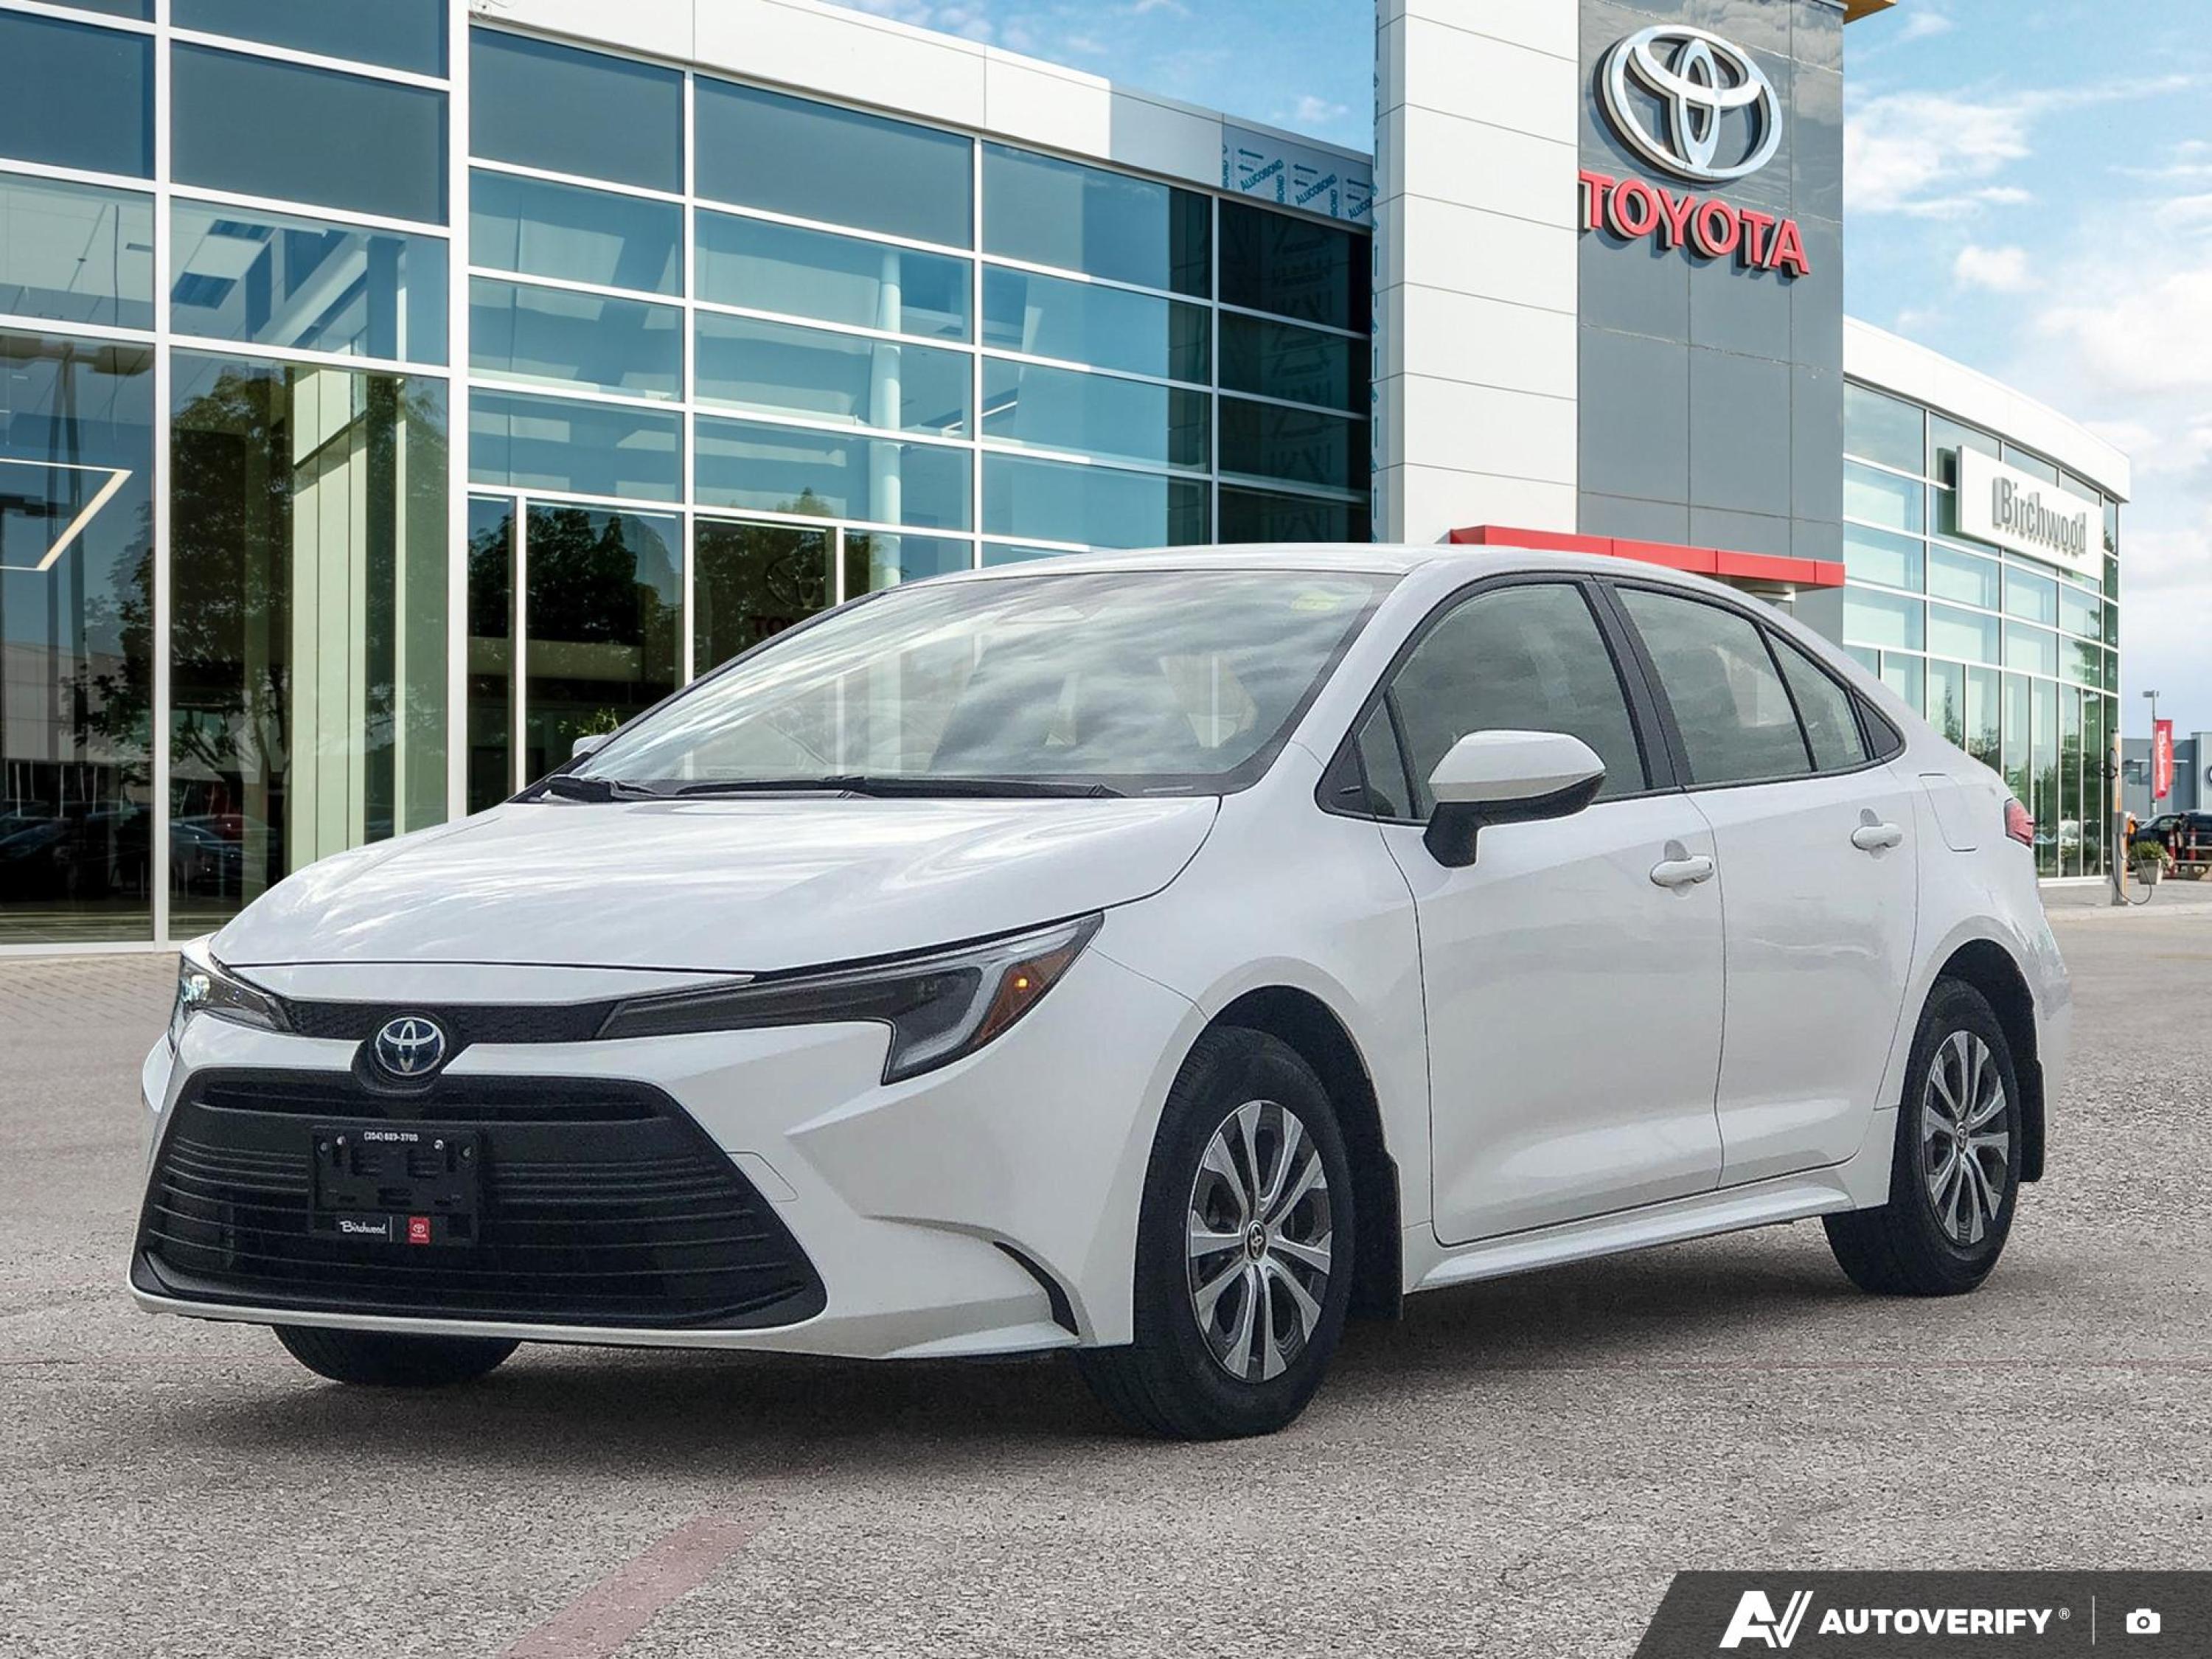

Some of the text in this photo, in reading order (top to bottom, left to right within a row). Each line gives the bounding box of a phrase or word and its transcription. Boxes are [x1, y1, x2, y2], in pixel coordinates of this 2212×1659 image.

[1240, 159, 1284, 192] ALUCOBOND
[1295, 174, 1337, 206] ALUCOBOND
[1579, 170, 1810, 275] TOYOTA
[1993, 476, 2086, 555] Birchwood
[338, 1220, 386, 1234] Birchwood
